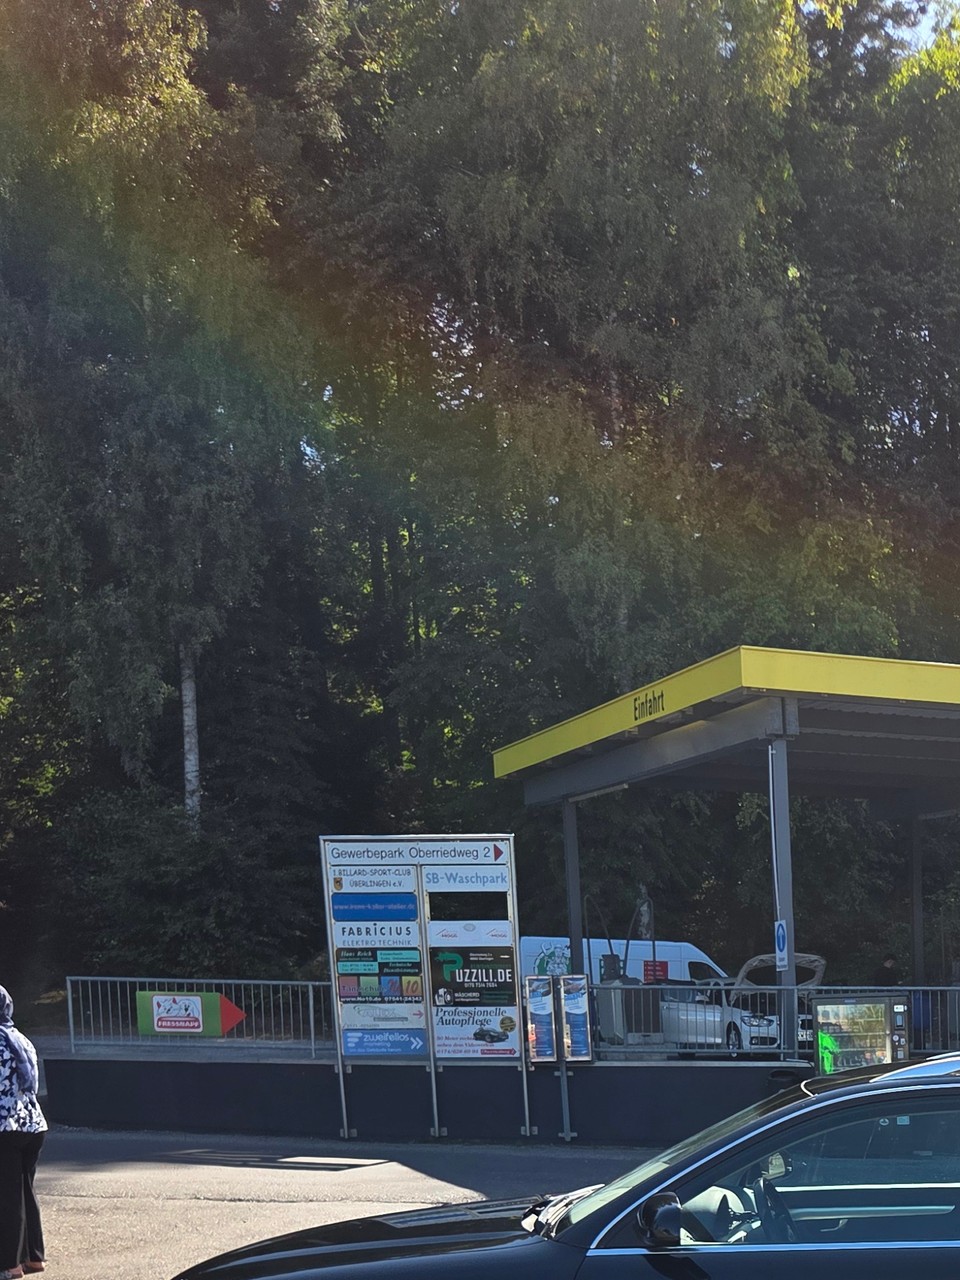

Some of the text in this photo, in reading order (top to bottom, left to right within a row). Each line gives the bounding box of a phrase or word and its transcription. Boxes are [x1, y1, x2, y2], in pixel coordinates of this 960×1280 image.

[633, 690, 665, 721] Einfahrt
[331, 846, 491, 860] Gewerbepark Oberriedweg 2
[425, 872, 508, 887] SB-Waschpark
[405, 980, 419, 994] 10
[435, 1007, 507, 1018] Professionelle
[436, 1016, 492, 1027] Autopflege
[363, 1032, 409, 1041] zweifellos
